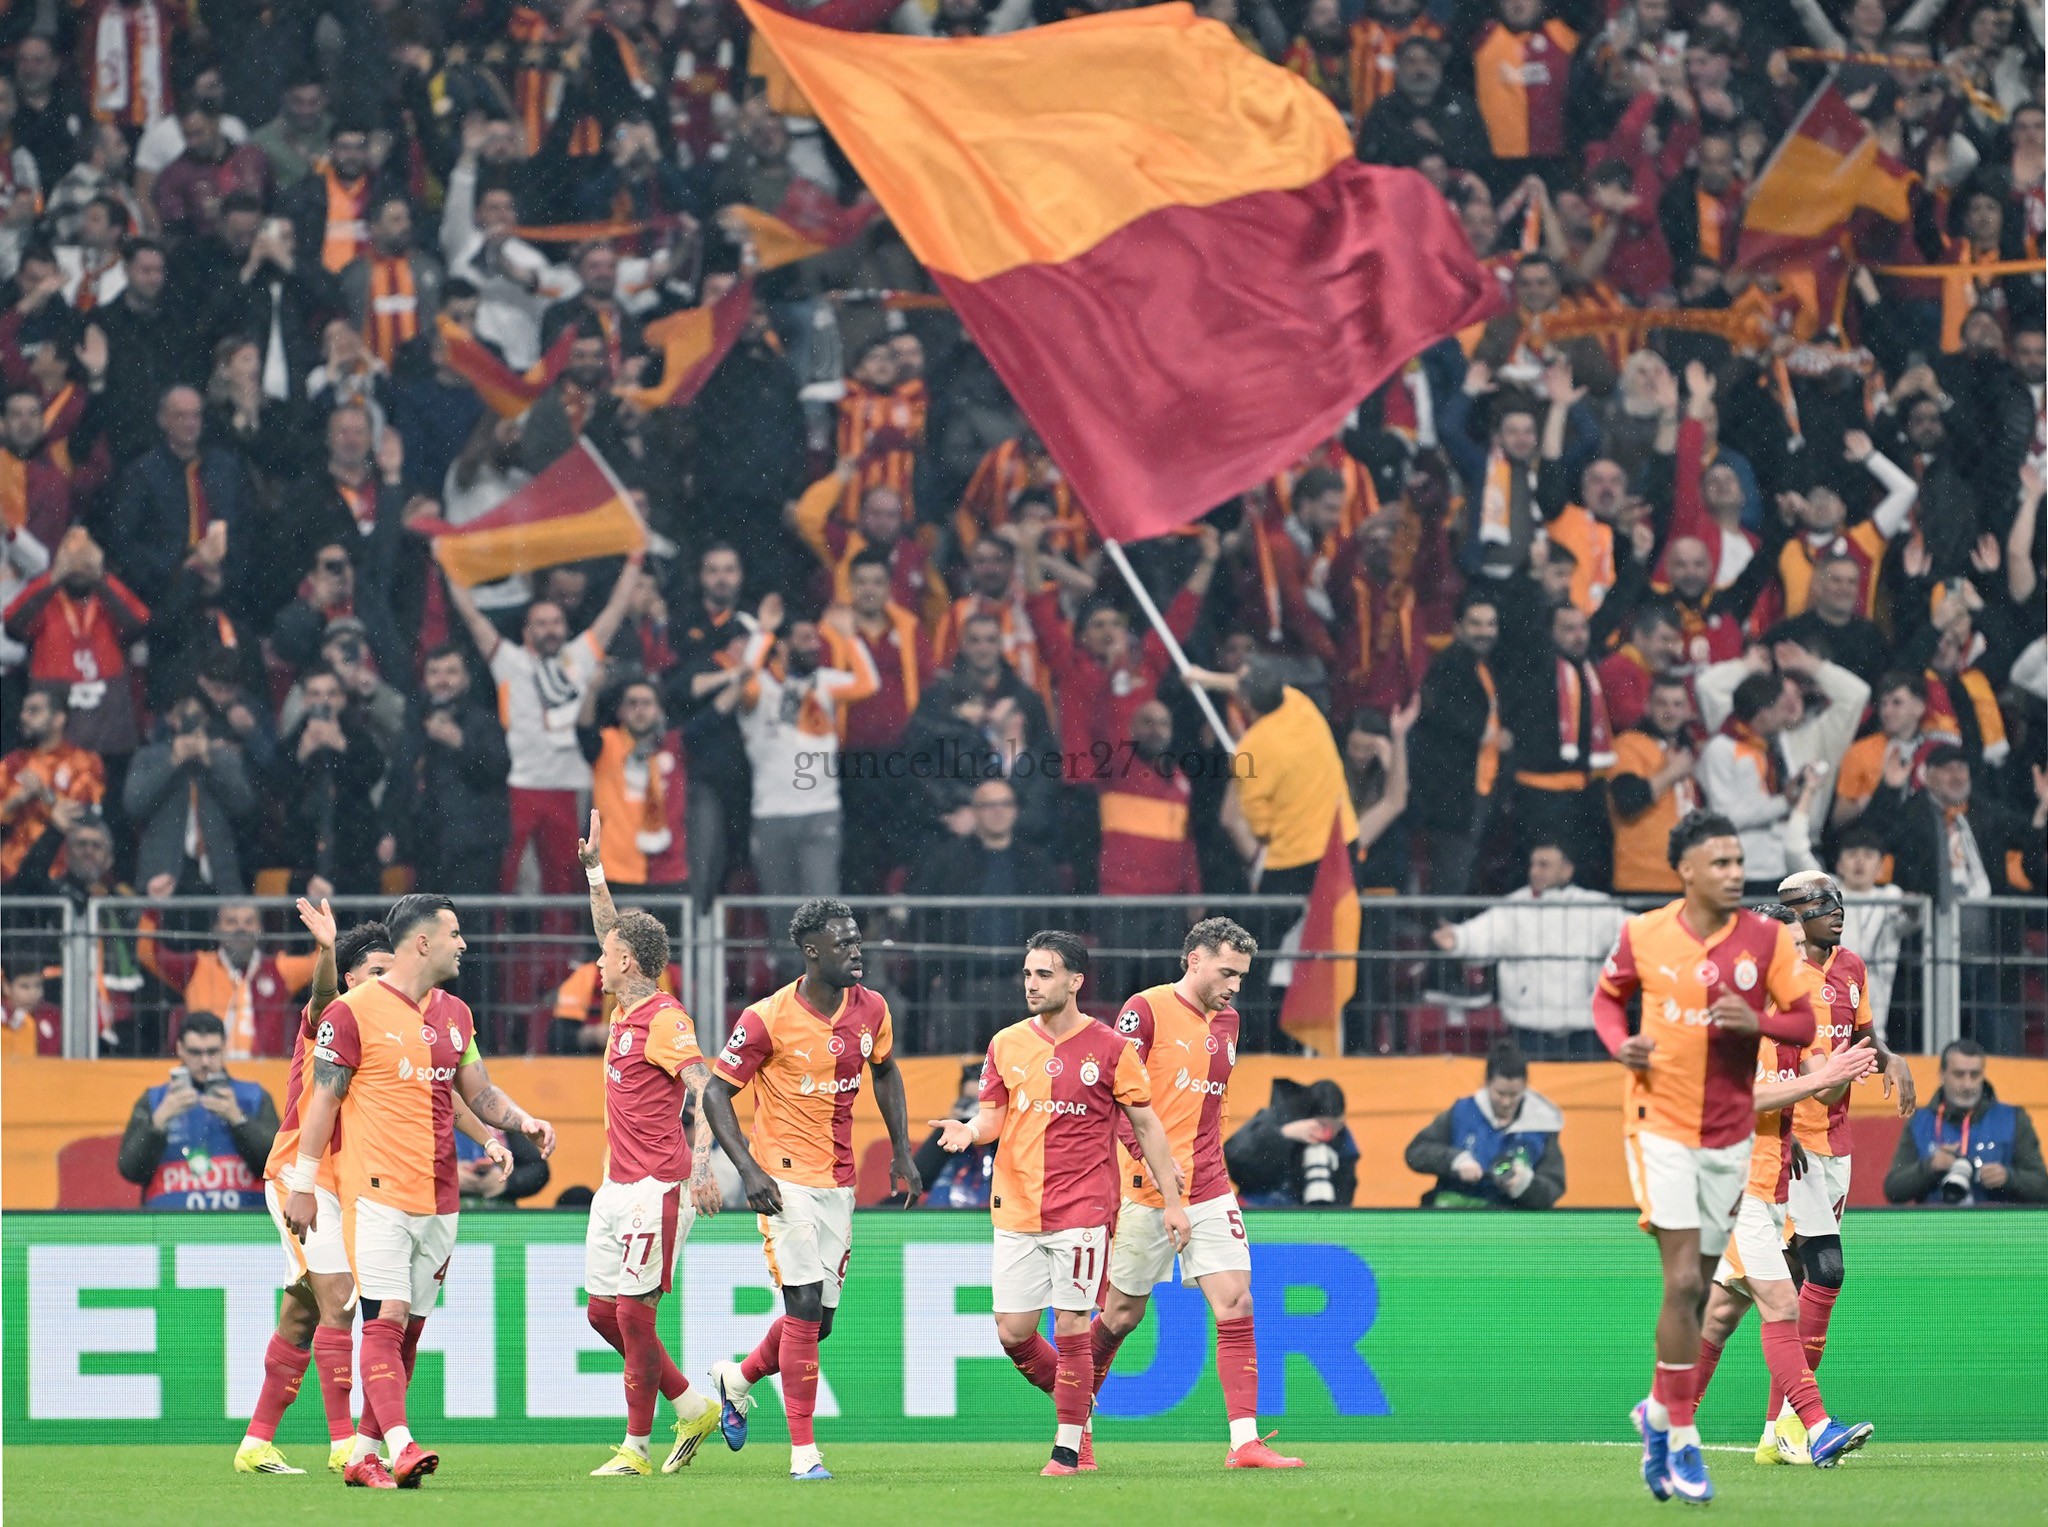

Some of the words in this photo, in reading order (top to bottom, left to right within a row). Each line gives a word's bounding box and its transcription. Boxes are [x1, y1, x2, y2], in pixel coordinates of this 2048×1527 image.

[818, 1073, 861, 1095] SOCAR
[1032, 1100, 1087, 1116] SOCAR
[162, 1160, 252, 1193] PHOTO
[1226, 1210, 1245, 1239] 5
[621, 1233, 655, 1265] 17
[1072, 1247, 1095, 1280] 11
[902, 1243, 1393, 1418] FOR
